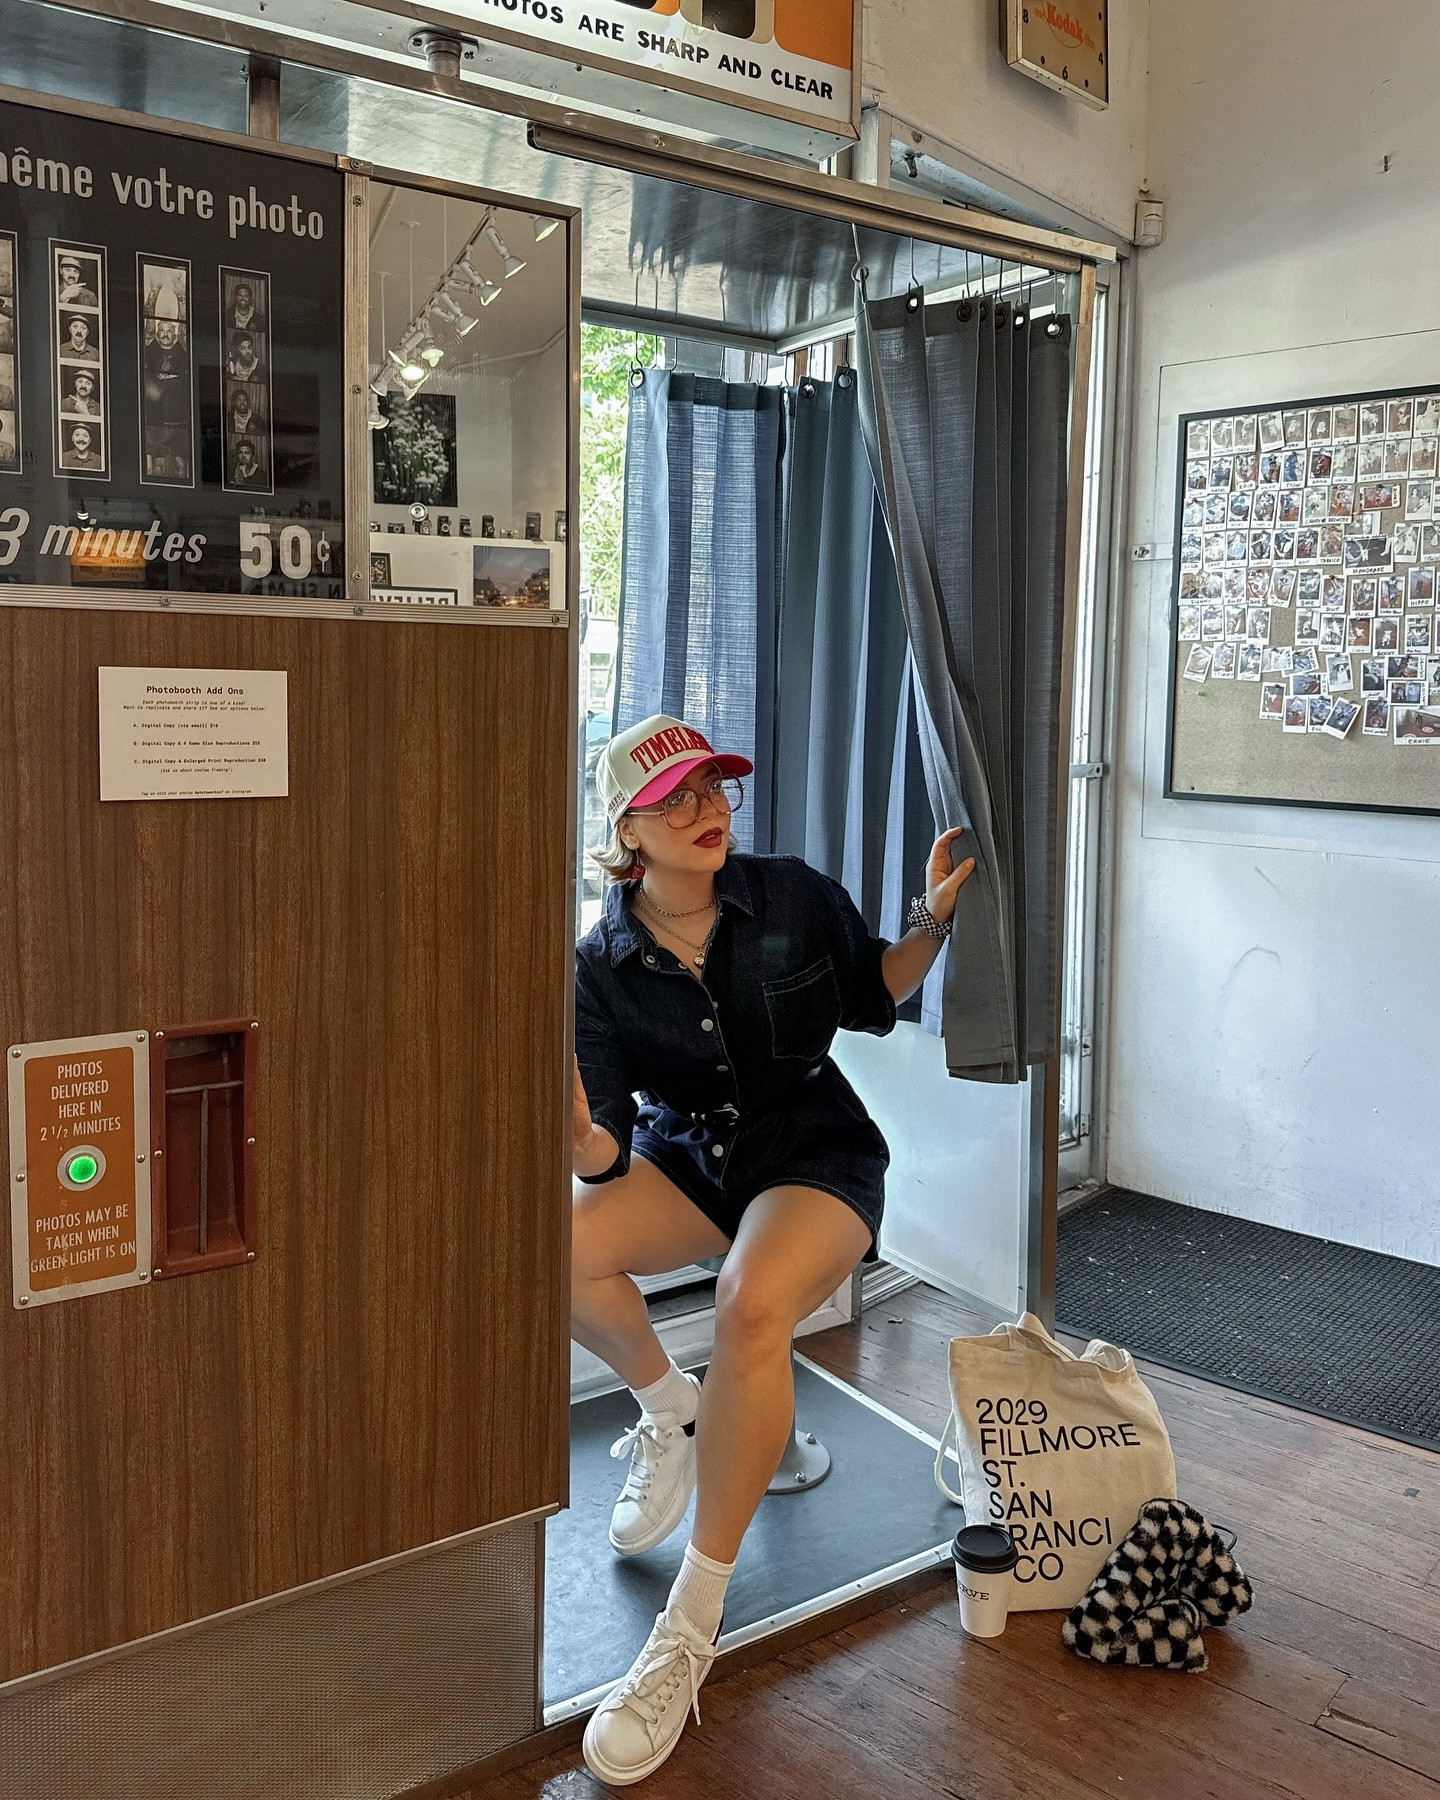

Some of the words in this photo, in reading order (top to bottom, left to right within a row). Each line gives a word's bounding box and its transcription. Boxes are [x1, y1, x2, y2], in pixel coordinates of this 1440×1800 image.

[1022, 9, 1029, 23] 8
[578, 15, 625, 42] ARE
[637, 30, 710, 64] SHARP
[717, 54, 762, 80] AND
[770, 68, 834, 101] CLEAR
[1062, 66, 1068, 80] 6
[0, 146, 93, 198] ême
[111, 167, 214, 220] votre
[228, 186, 324, 240] photo
[39, 518, 207, 563] minutes
[239, 520, 330, 580] 50¢
[146, 686, 202, 695] Photobooth
[206, 687, 223, 695] Add
[227, 687, 244, 695] Ons
[57, 1060, 103, 1080] PHOTOS
[51, 1079, 109, 1101] DELIVERED
[58, 1103, 86, 1119] HERE
[90, 1100, 102, 1115] IN
[40, 1126, 48, 1141] 2
[73, 1116, 121, 1137] MINUTES
[35, 1212, 81, 1233] PHOTOS
[85, 1207, 112, 1224] MAY
[115, 1204, 129, 1218] BE
[46, 1231, 83, 1251] TAKEN
[87, 1225, 120, 1243] WHEN
[30, 1254, 67, 1273] GREEN
[70, 1247, 101, 1266] LIGHT
[105, 1244, 116, 1258] IS
[120, 1241, 136, 1255] ON
[975, 1397, 1048, 1426] 2029
[979, 1423, 1141, 1456] FILLMORE
[982, 1459, 1026, 1489] ST.
[988, 1490, 1053, 1520] SAN
[990, 1517, 1113, 1551] RANCI
[1011, 1553, 1064, 1584] CO
